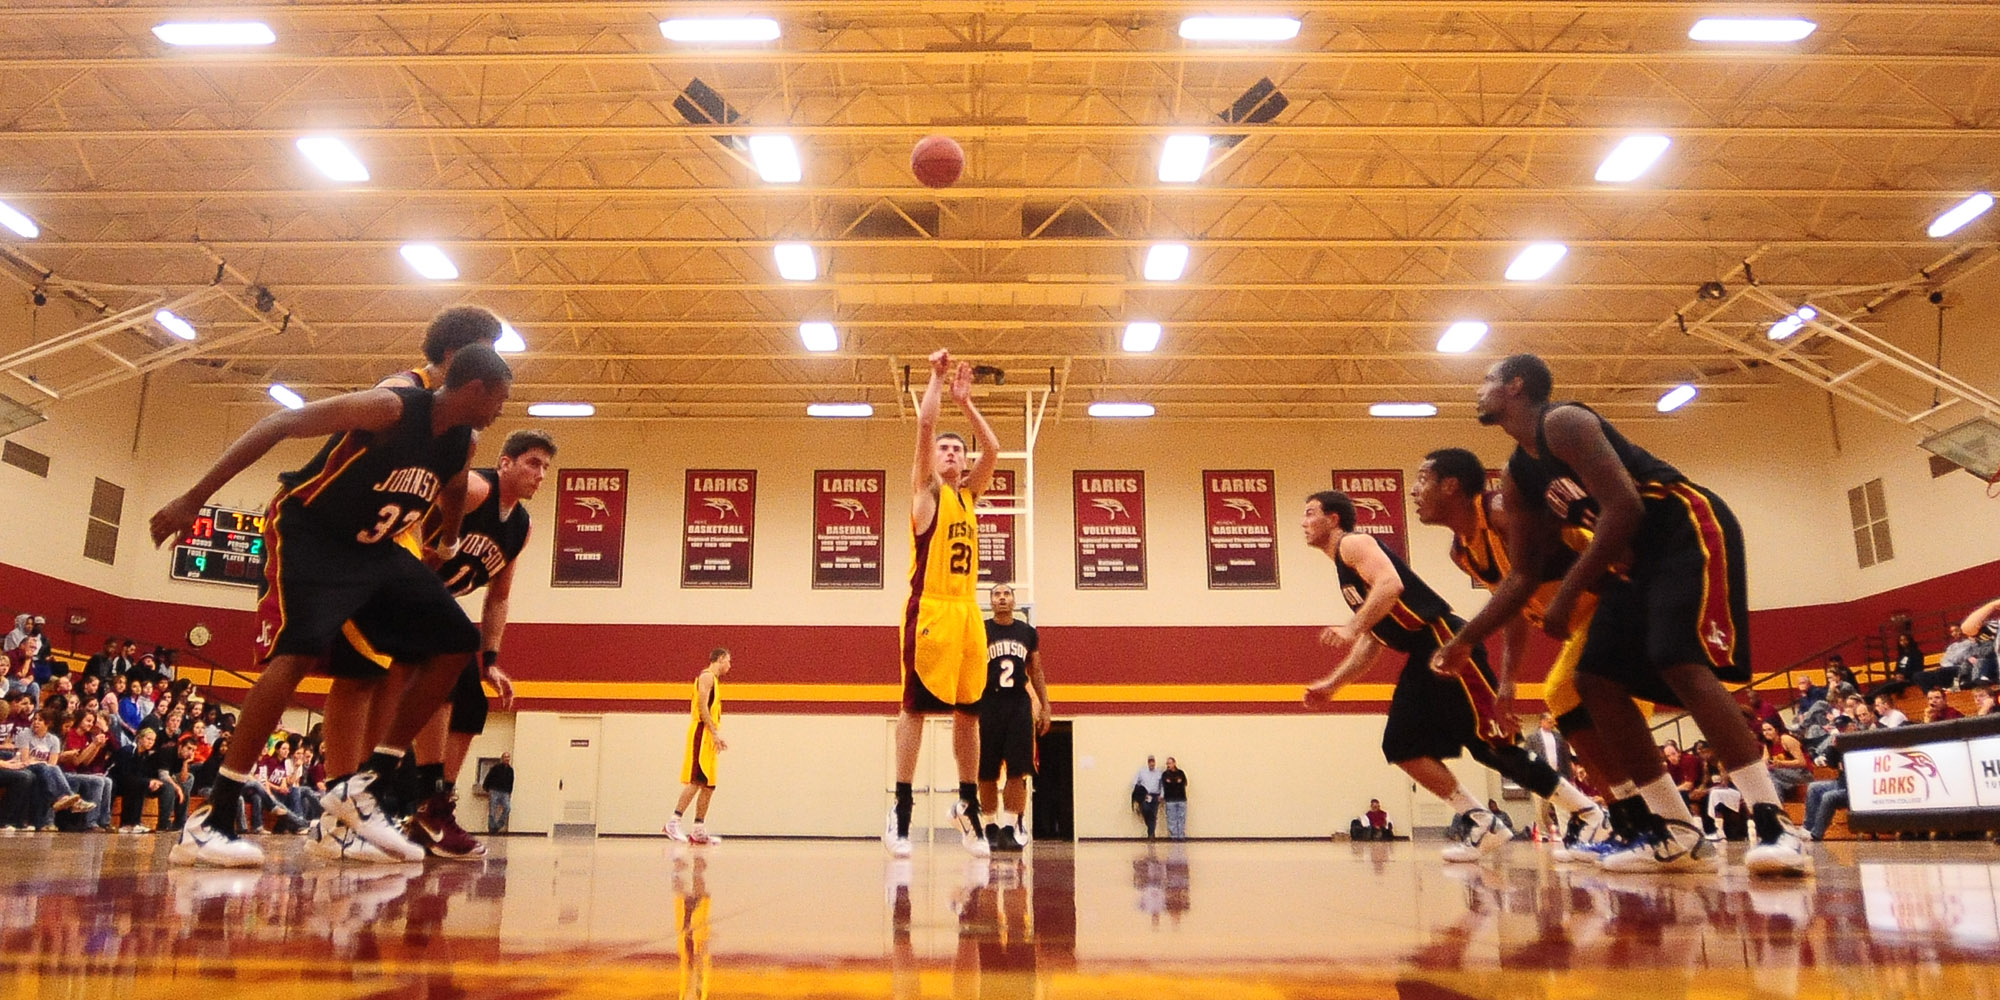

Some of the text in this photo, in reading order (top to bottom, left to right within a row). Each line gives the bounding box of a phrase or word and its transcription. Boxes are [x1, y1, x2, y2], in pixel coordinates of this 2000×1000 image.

[566, 477, 620, 491] LARKS
[694, 478, 749, 492] LARKS
[823, 478, 878, 493] LARKS
[1082, 478, 1137, 493] LARKS
[1212, 478, 1267, 492] LARKS
[1342, 478, 1397, 492] LARKS
[577, 524, 603, 532] TENNIS
[688, 525, 744, 534] BASKETBALL
[826, 526, 872, 535] BASEBALL
[1082, 526, 1138, 535] VOLLEYBALL
[1212, 525, 1269, 535] BASKETBALL
[250, 538, 263, 555] 2
[195, 556, 207, 572] 9
[999, 658, 1015, 688] 2
[1873, 754, 1892, 773] HC
[1872, 776, 1916, 795] LARKS
